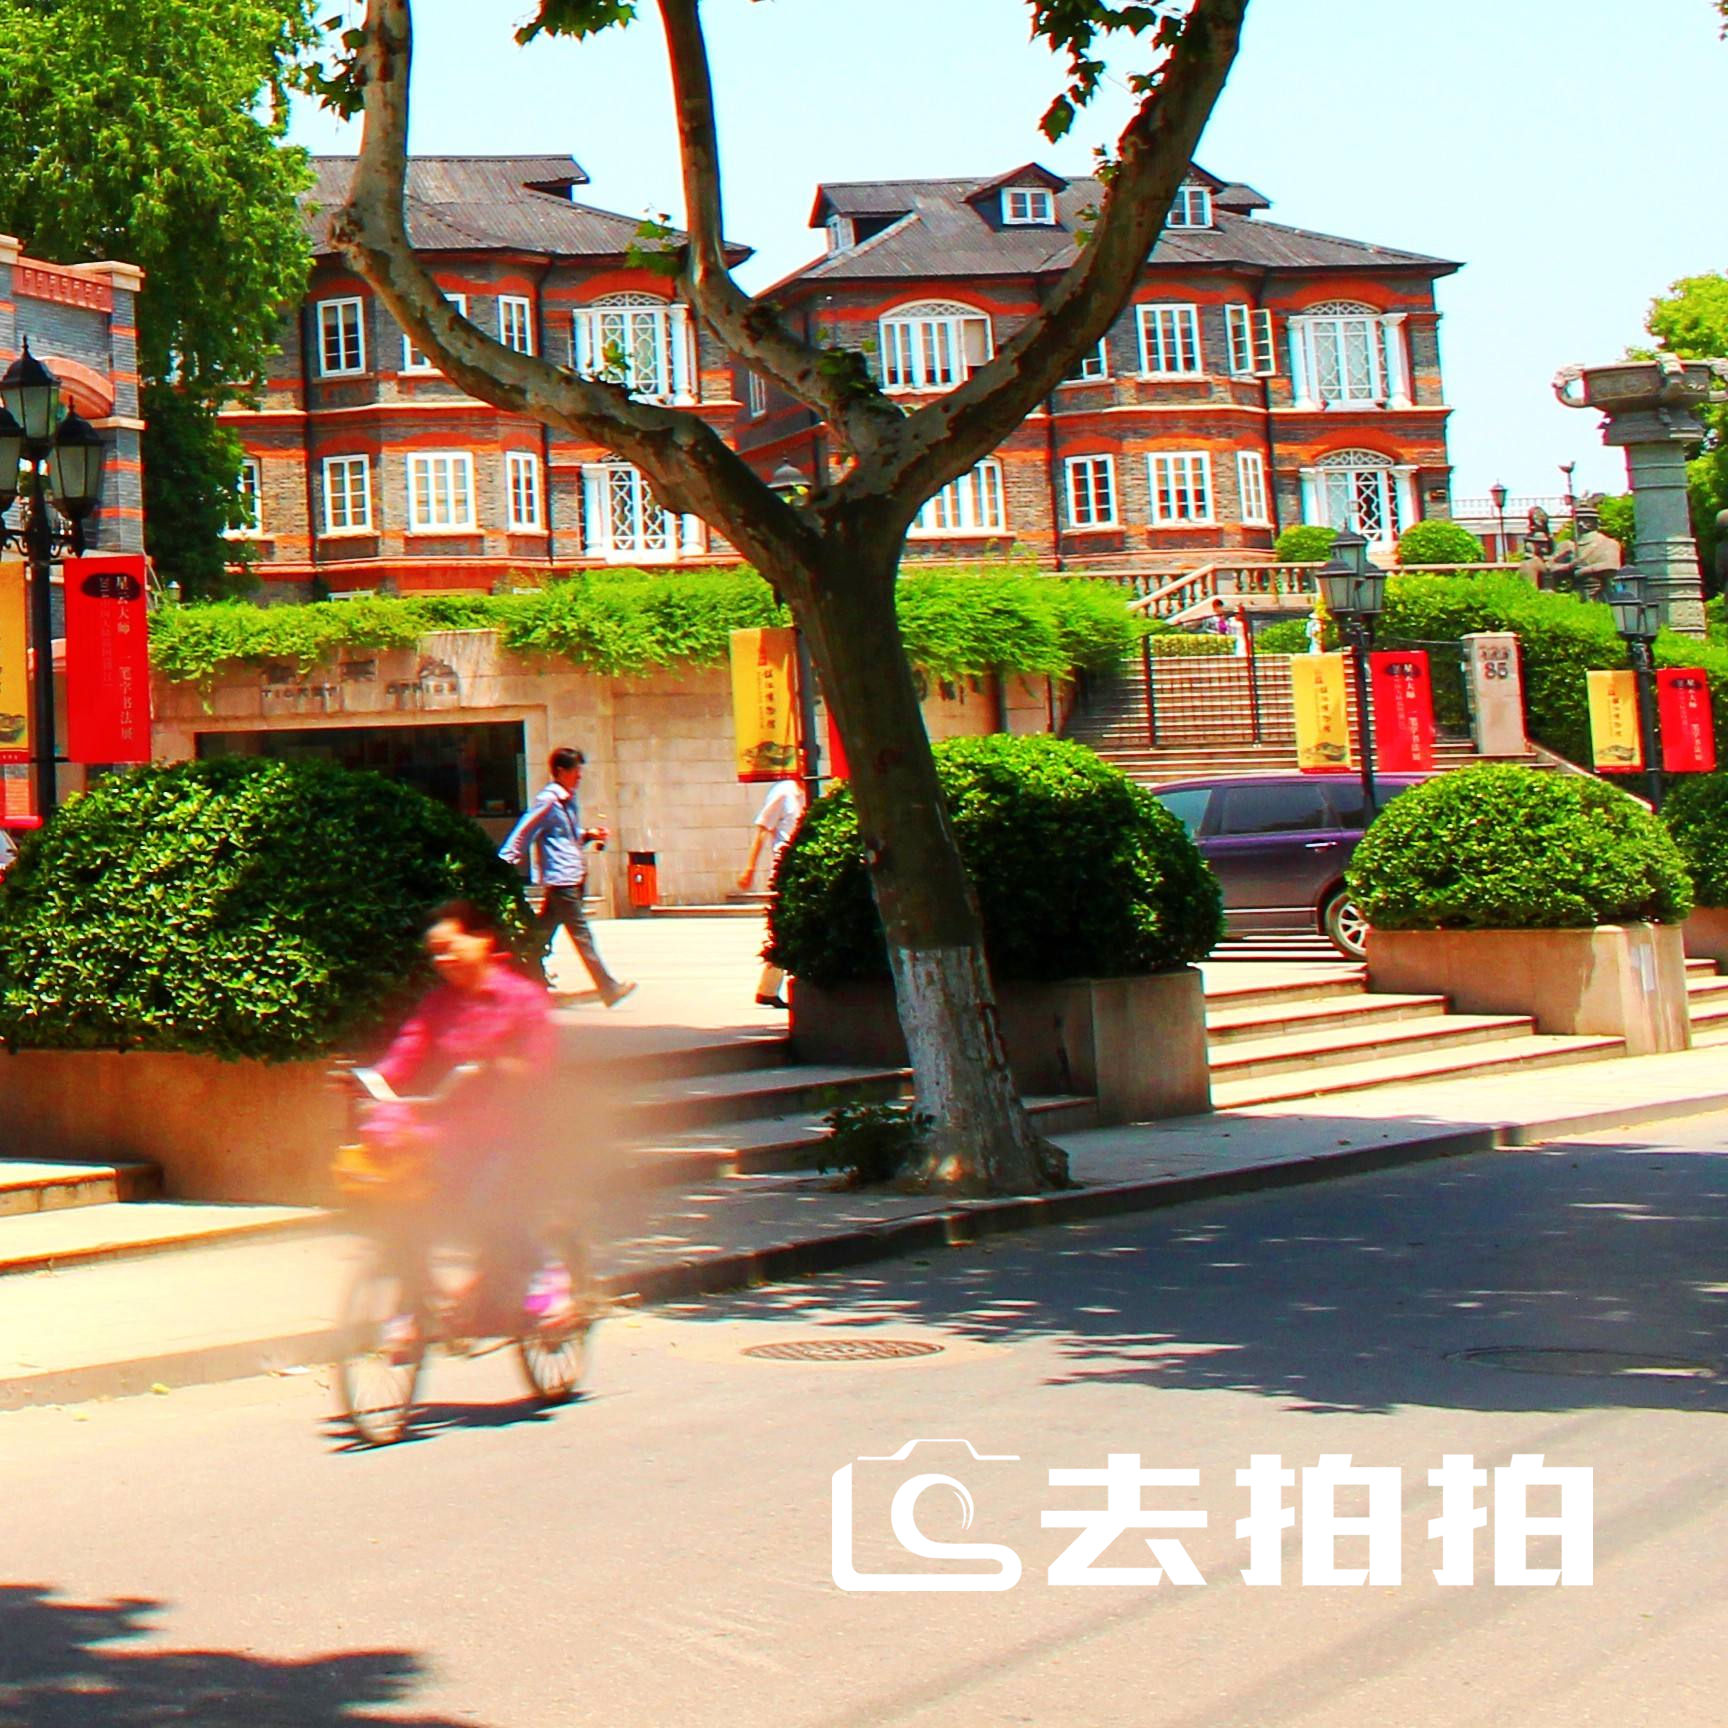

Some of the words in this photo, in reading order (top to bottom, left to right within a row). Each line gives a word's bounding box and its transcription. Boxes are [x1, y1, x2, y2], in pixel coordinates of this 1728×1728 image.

[116, 575, 131, 635] 星云大师
[262, 685, 338, 700] TICKET
